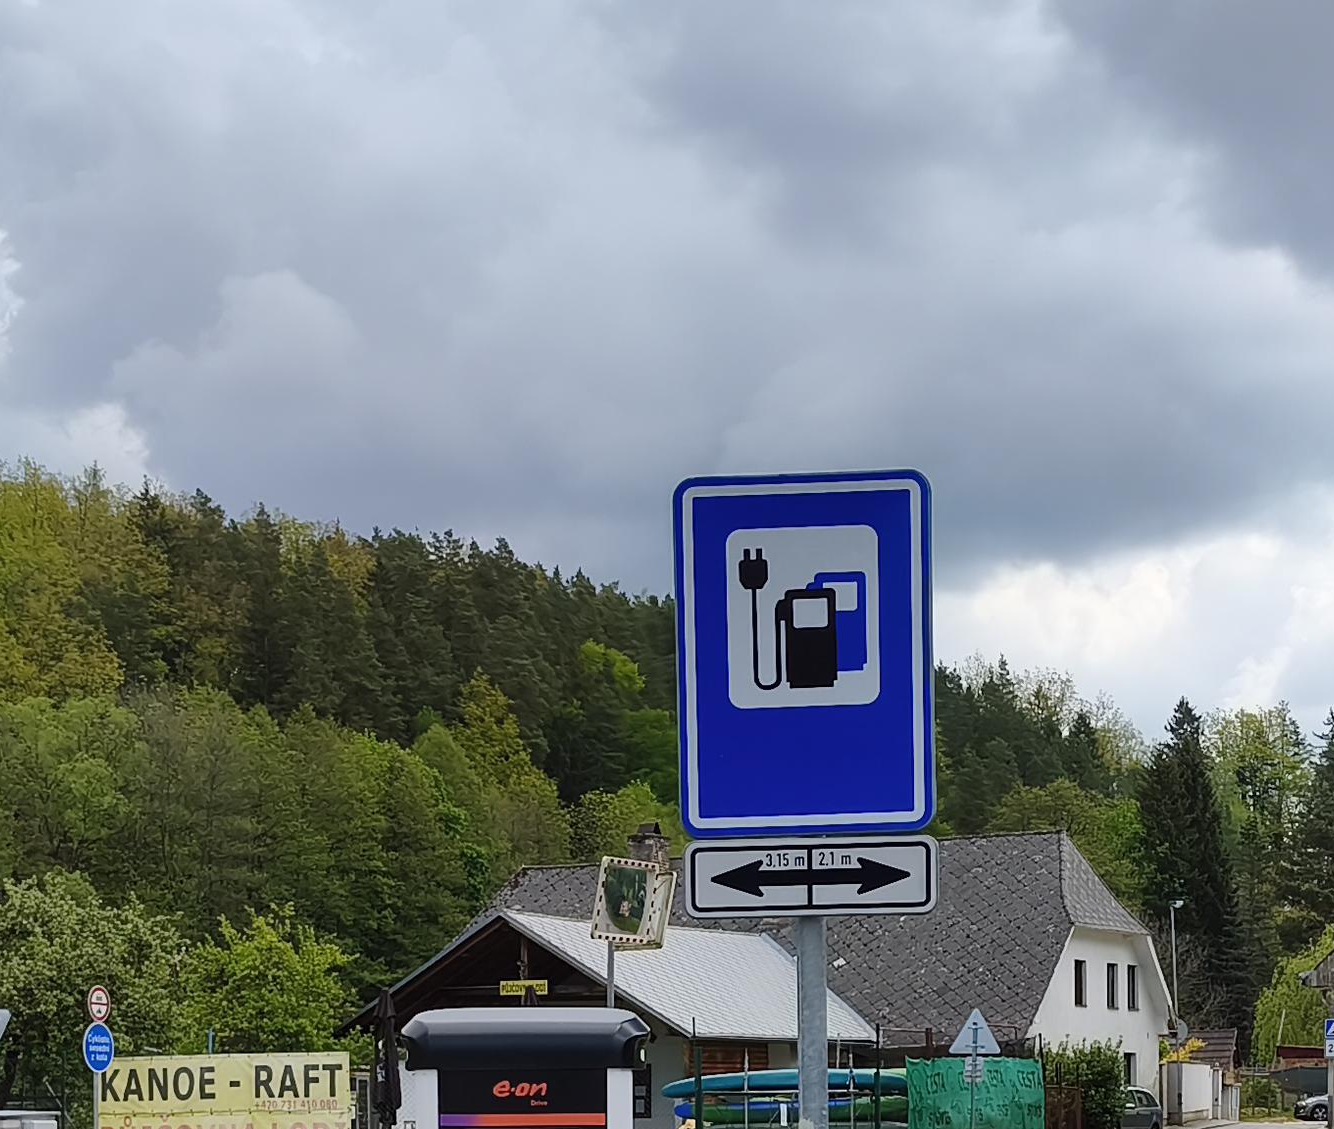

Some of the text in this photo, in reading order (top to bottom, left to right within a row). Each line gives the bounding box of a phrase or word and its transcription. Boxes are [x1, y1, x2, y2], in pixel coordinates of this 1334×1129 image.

[765, 853, 805, 868] 3.15 m
[818, 851, 852, 866] 2.1 m
[101, 1065, 216, 1102] KANOE
[254, 1063, 343, 1098] RAFT
